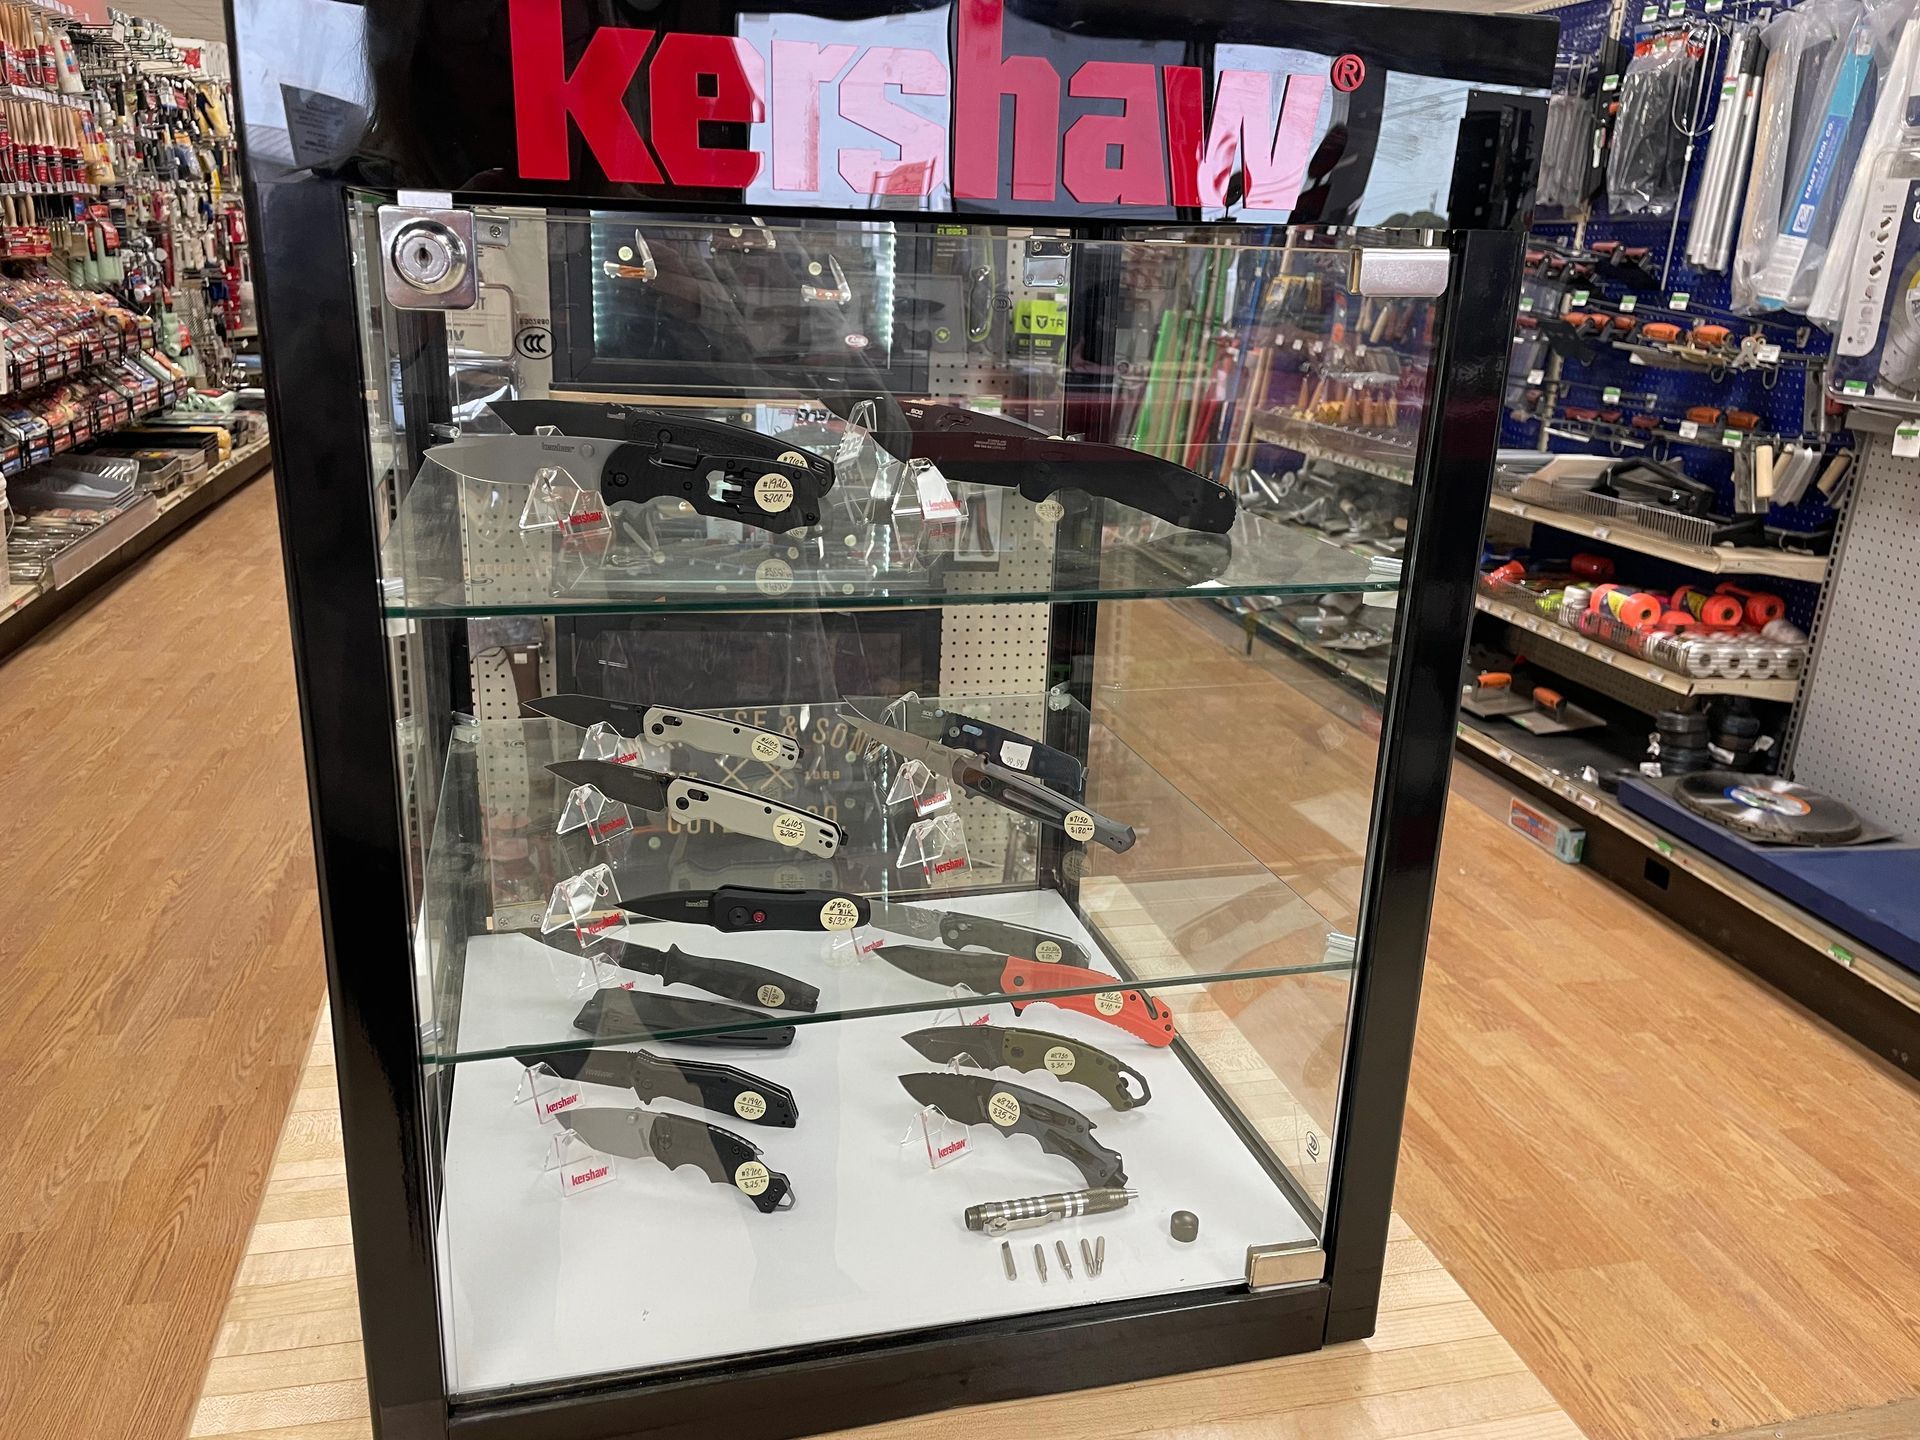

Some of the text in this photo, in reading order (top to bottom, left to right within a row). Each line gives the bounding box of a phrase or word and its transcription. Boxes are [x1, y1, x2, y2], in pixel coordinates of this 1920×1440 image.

[934, 857, 965, 874] kershaw
[546, 1094, 578, 1114] kershaw
[937, 1138, 967, 1159] kershaw
[571, 1165, 609, 1186] kershaw
